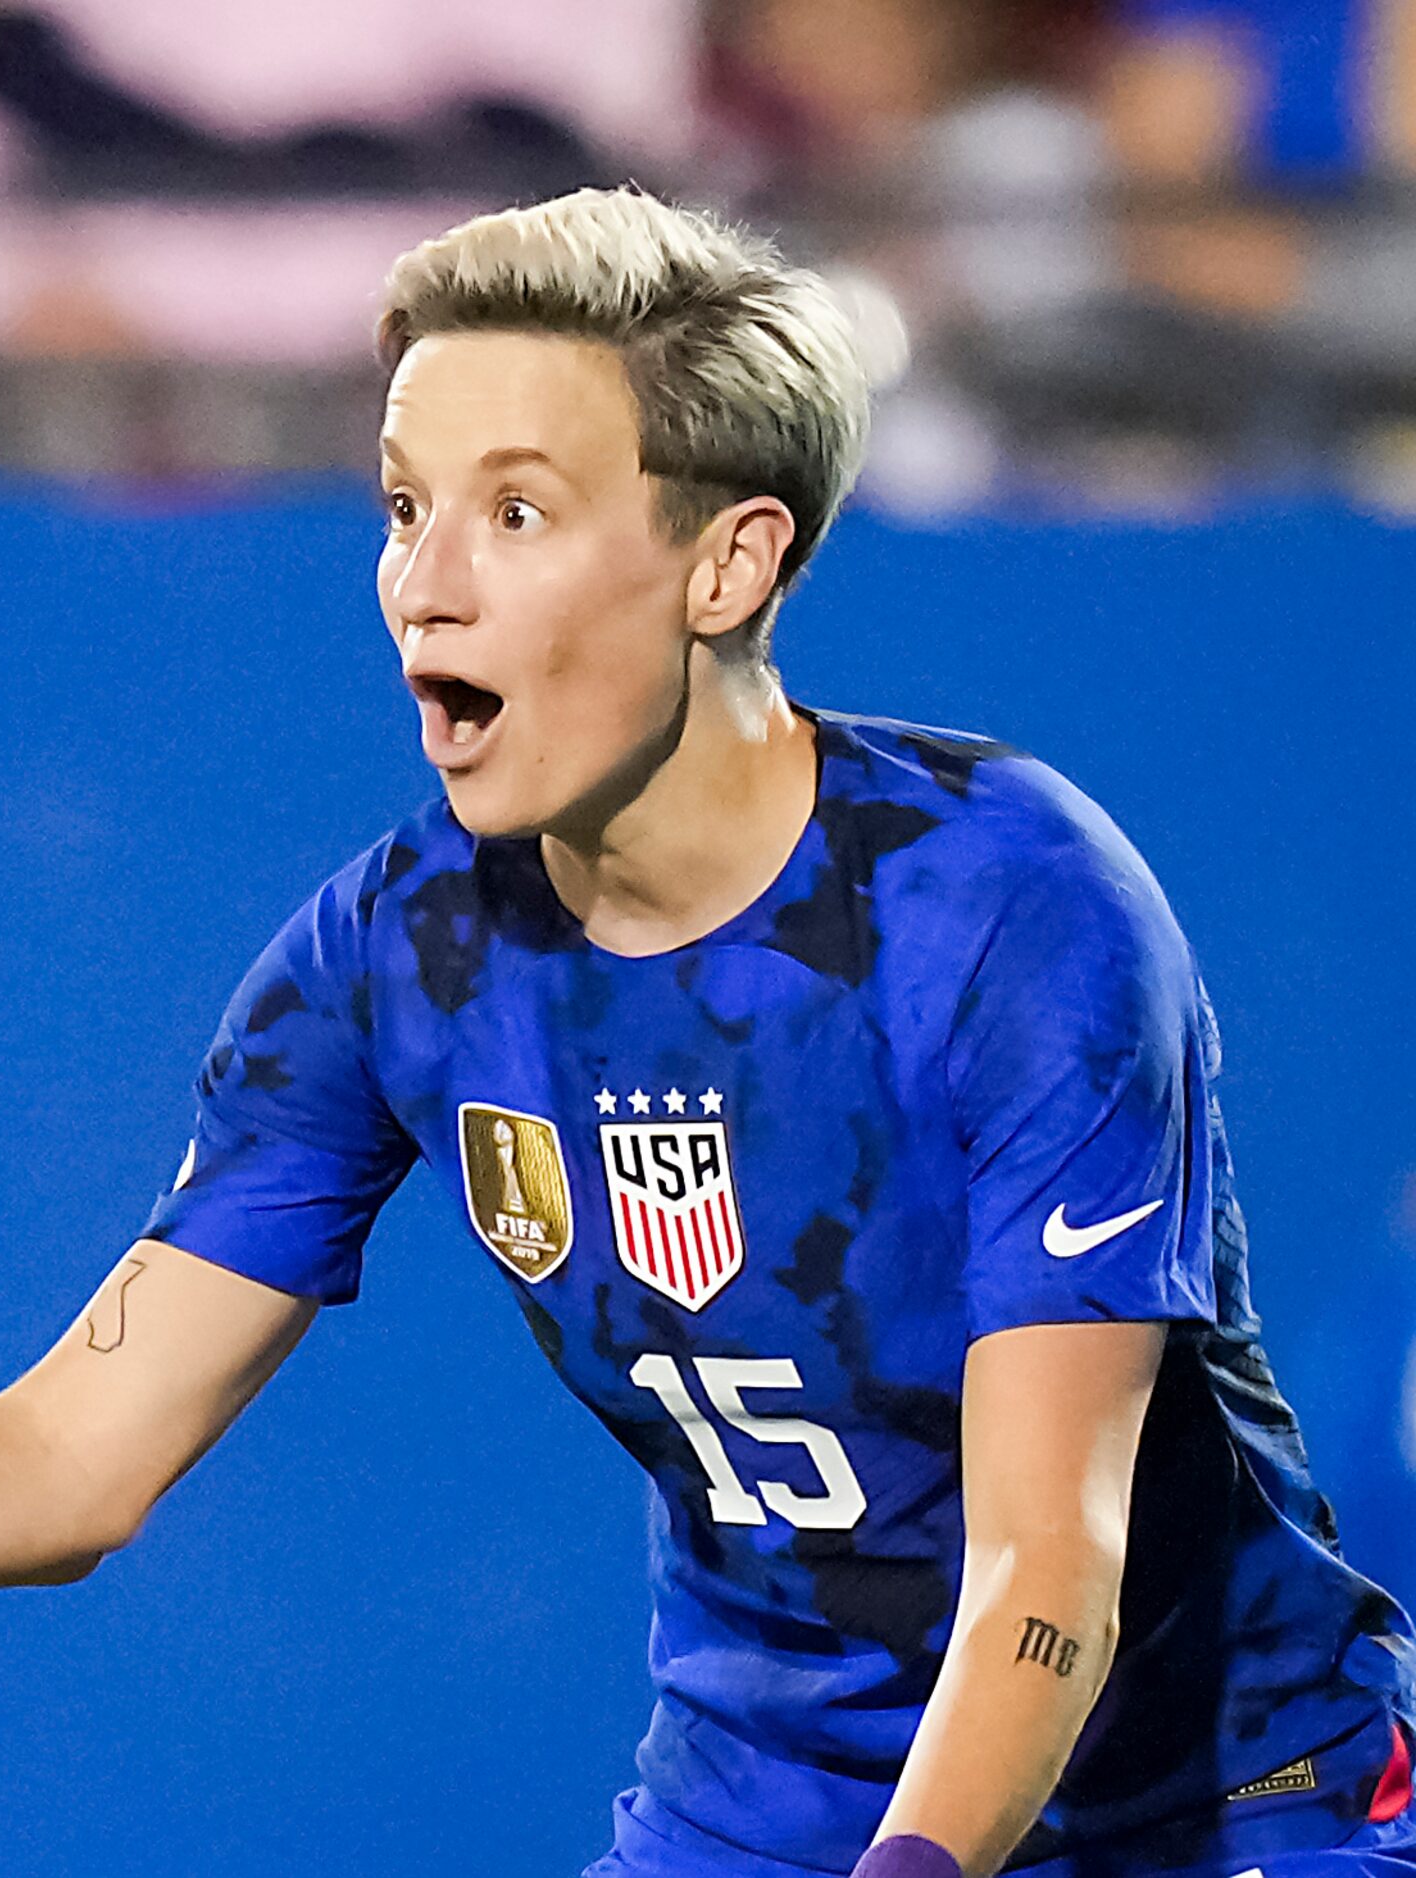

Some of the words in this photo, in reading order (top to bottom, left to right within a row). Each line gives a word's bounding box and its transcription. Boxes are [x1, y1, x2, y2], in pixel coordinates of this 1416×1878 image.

[611, 1134, 721, 1201] USA
[495, 1213, 546, 1242] FIFA
[629, 1354, 867, 1529] 15
